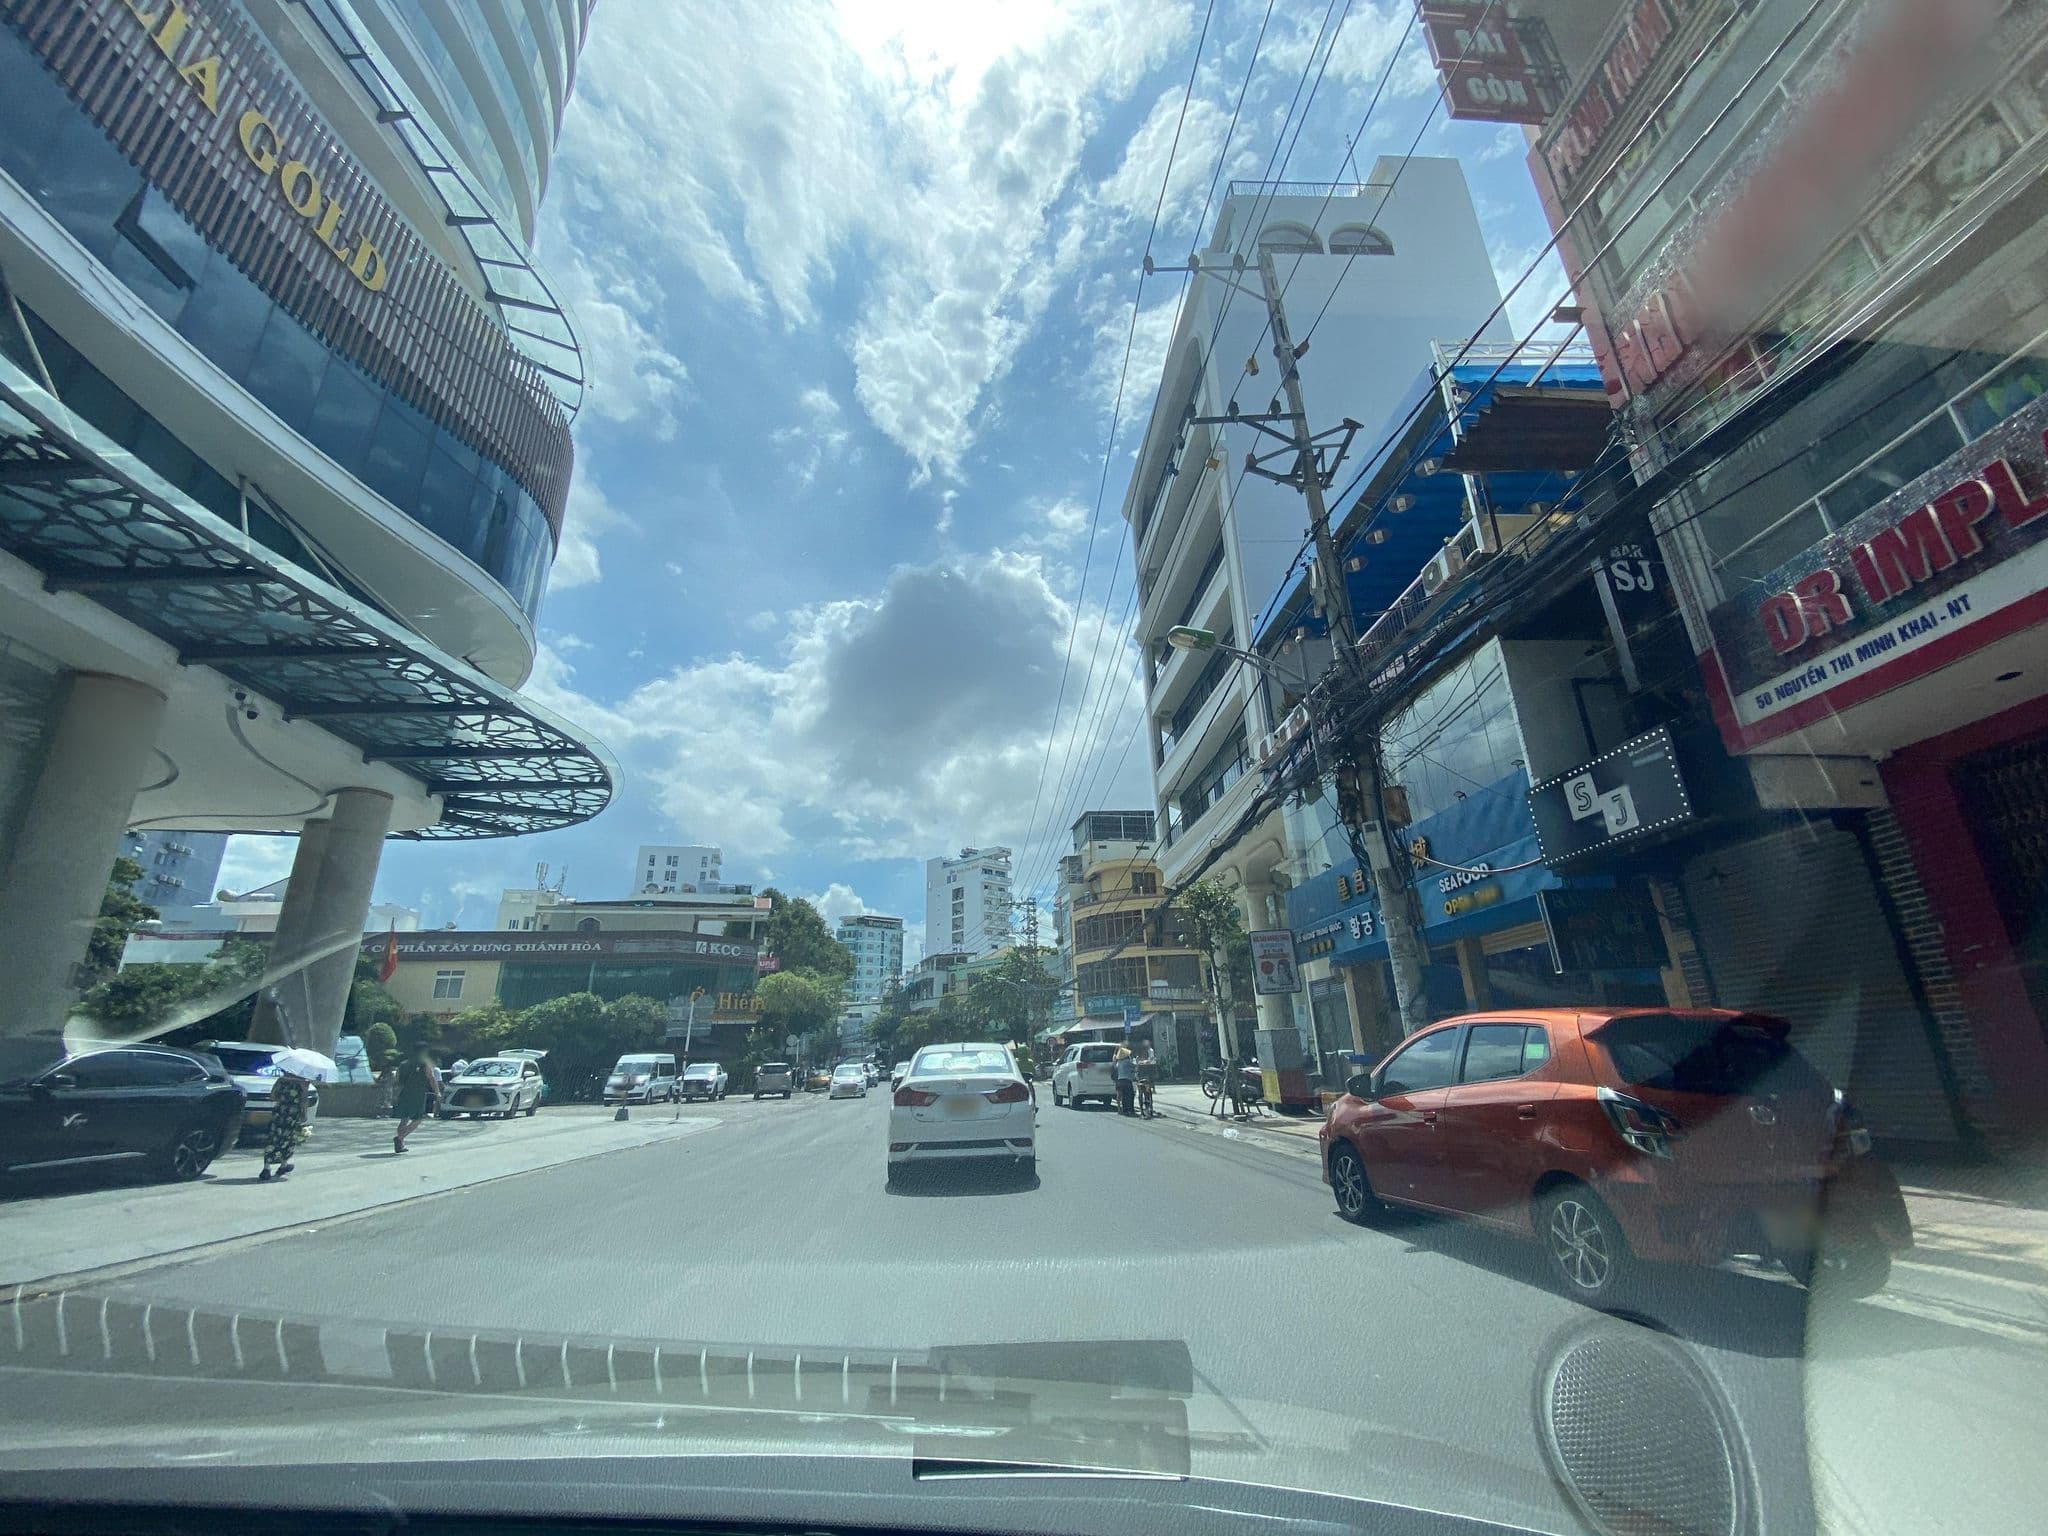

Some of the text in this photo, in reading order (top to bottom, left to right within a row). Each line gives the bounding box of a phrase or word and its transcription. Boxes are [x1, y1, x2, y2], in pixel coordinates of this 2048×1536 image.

[126, 0, 386, 291] IA GOLD
[1759, 430, 2048, 656] DR IMPL
[1610, 560, 1654, 591] SJ
[1755, 694, 1773, 710] 50
[1855, 632, 1898, 663] MINH
[1897, 611, 1939, 643] KHAI
[1946, 594, 1972, 619] NT
[1438, 862, 1490, 893] SEAFOOD
[515, 941, 569, 952] KHÁNH
[710, 944, 742, 957] KCC
